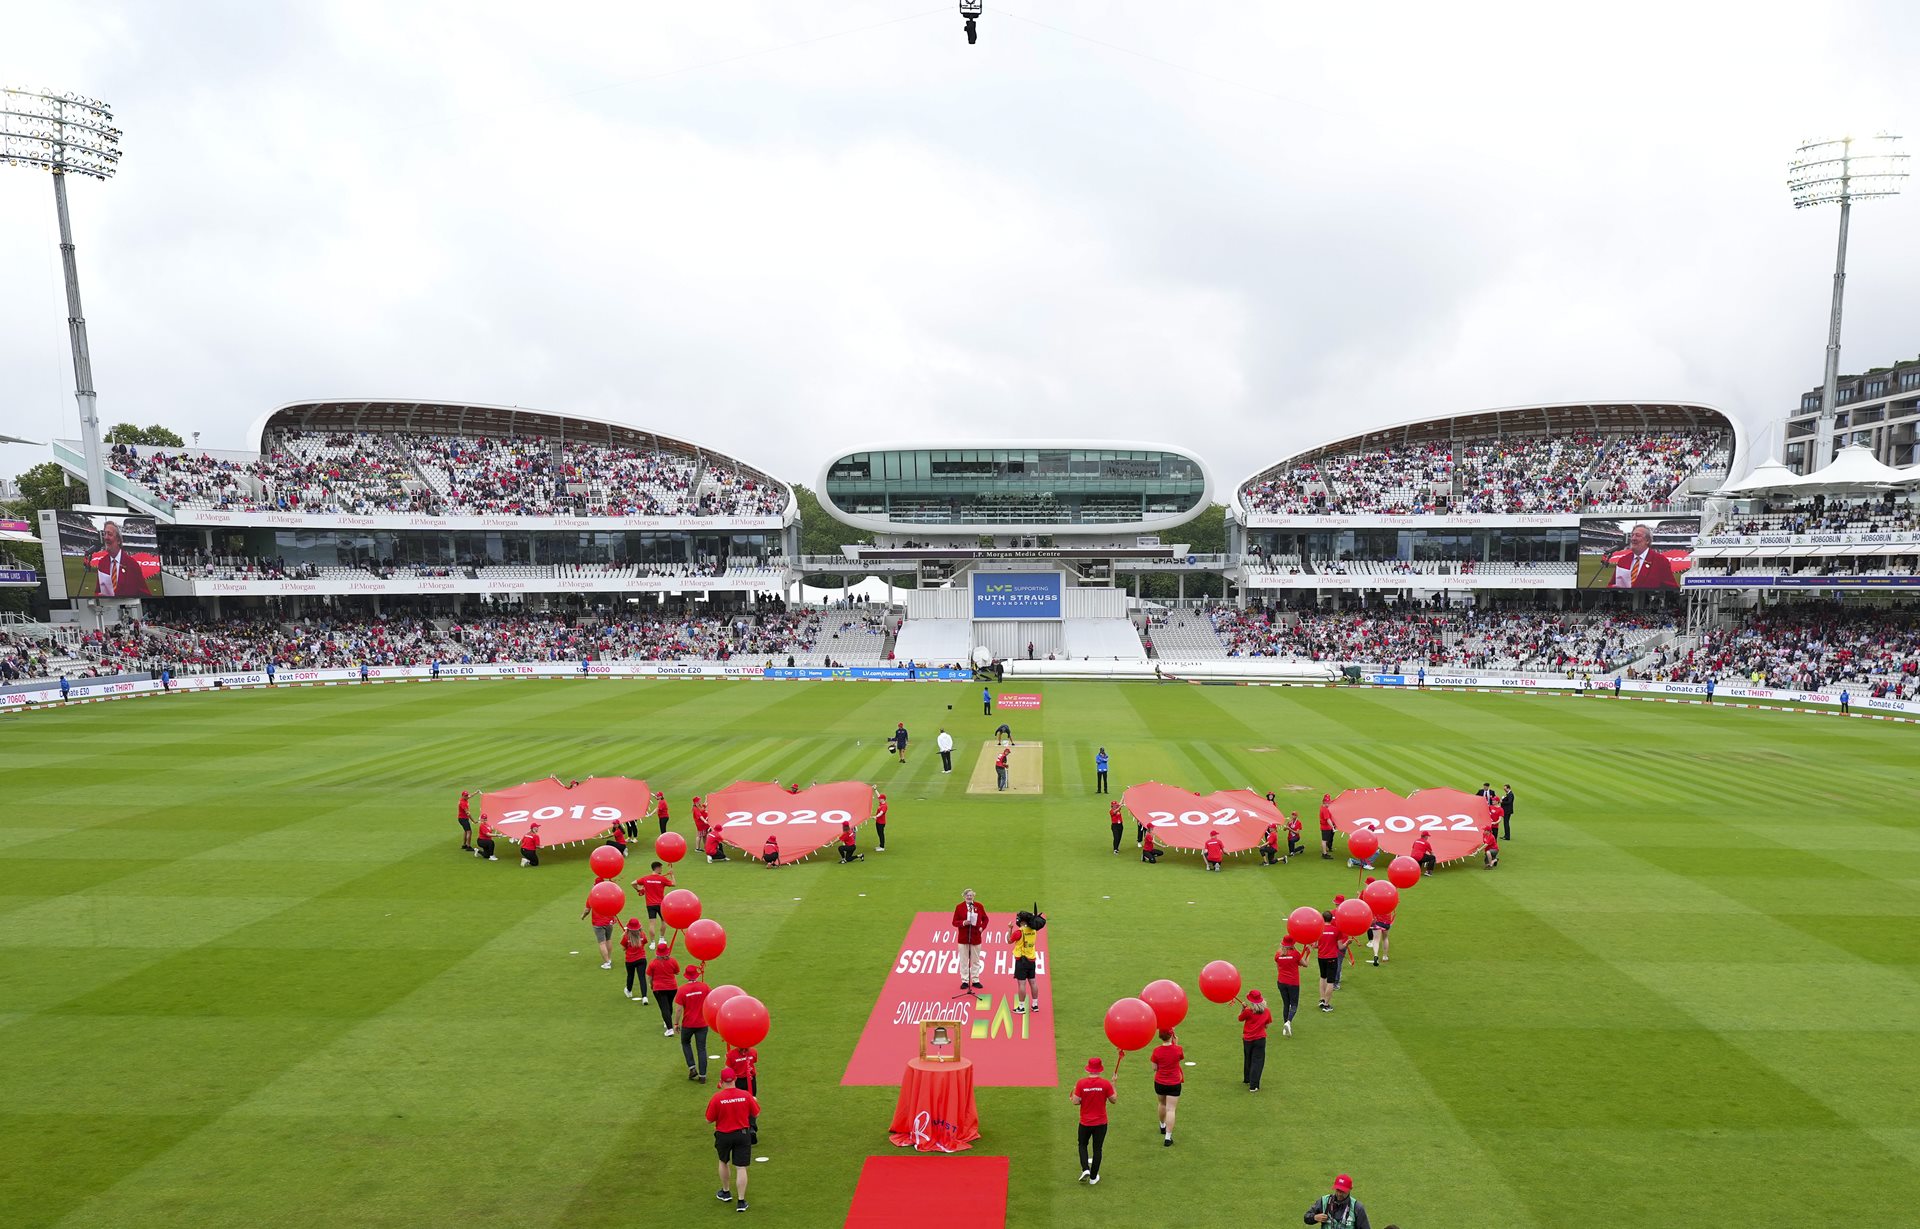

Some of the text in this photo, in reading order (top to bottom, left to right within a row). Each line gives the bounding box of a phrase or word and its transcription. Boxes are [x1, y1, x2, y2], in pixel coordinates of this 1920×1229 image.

[116, 683, 134, 691] THIRTY
[7, 694, 26, 703] 70600
[1808, 694, 1829, 702] 70600
[1869, 700, 1904, 710] Donate £40
[498, 805, 622, 824] 2019
[723, 810, 852, 827] 2020
[1353, 814, 1478, 833] 2022
[894, 1002, 970, 1025] SUPPORTING
